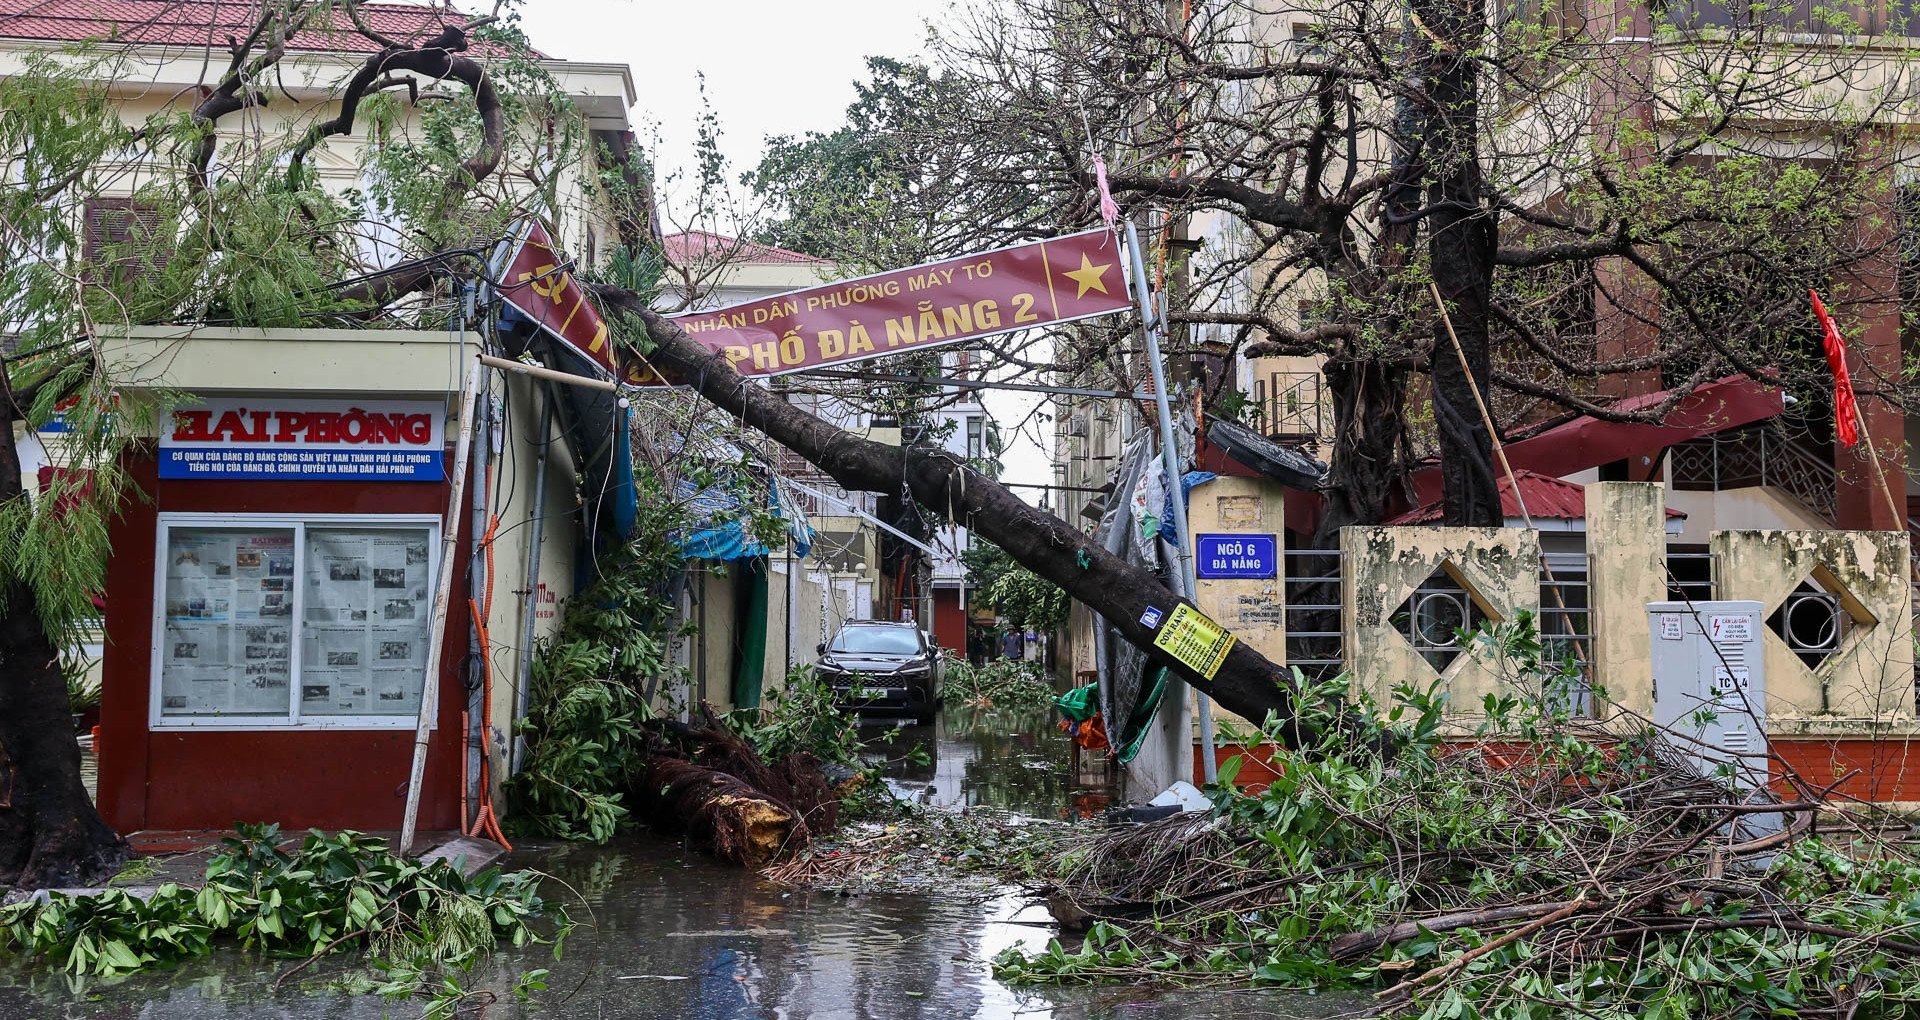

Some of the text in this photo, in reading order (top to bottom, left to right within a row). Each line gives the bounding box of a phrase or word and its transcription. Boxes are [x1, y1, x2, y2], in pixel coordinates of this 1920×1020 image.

[685, 259, 993, 334] NHÂN DÂN PHƯỜNG MÁY TƠ
[724, 324, 806, 371] PHỐ
[817, 320, 876, 360] ĐÀ
[884, 300, 1001, 347] NẴNG
[1011, 293, 1038, 324] 2
[172, 450, 431, 464] CƠ QUAN CỦA ĐẢNG BỘ ĐẢNG CỘNG SẢN VIỆT NAM THÀNH PHỐ HẢI PHÒNG
[189, 462, 210, 472] TIẾNG
[212, 462, 224, 472] NÓI
[226, 462, 241, 472] CỦA
[243, 462, 262, 472] ĐẢNG
[278, 463, 300, 472] CHÍNH
[302, 462, 326, 474] QUYỀN
[327, 463, 337, 473] VÀ
[338, 463, 358, 473] NHÂN
[360, 464, 374, 473] DÂN
[376, 462, 388, 474] HẢI
[390, 464, 414, 474] PHÒNG
[1217, 541, 1256, 556] NGÕ 6
[1212, 556, 1261, 569] ĐÀ NẴNG
[1144, 611, 1158, 624] 04
[1172, 608, 1188, 630] RANG
[1719, 677, 1731, 688] TC
